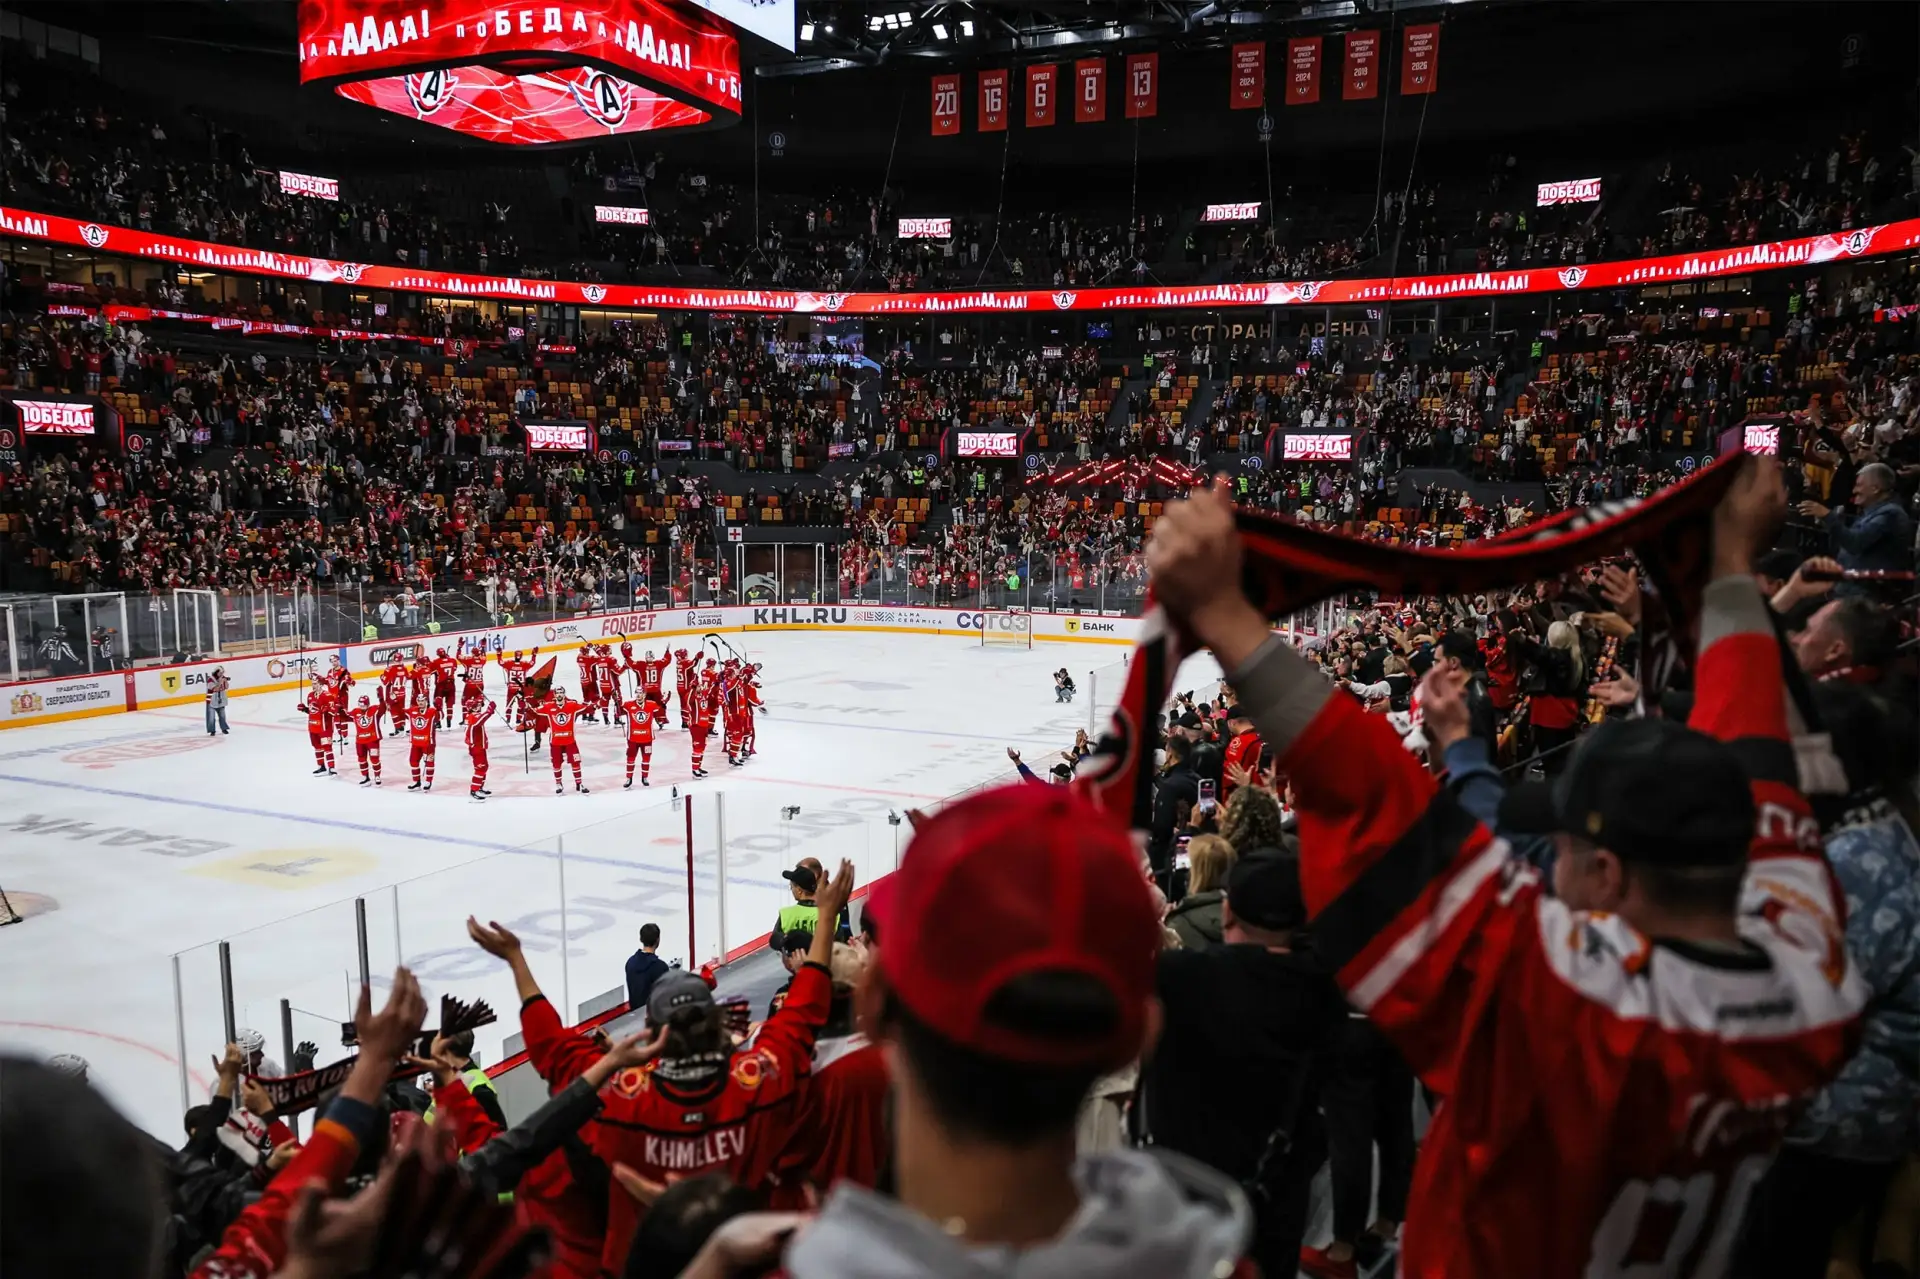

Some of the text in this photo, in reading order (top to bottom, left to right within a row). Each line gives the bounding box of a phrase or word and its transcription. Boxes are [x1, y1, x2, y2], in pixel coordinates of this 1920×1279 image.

[1085, 76, 1097, 101] 8
[1133, 70, 1151, 96] 13
[984, 88, 1002, 113] 16
[1035, 83, 1047, 107] 6
[935, 91, 957, 116] 20
[283, 175, 336, 196] ПОБЕДА!
[1541, 184, 1597, 199] ПОБЕДА!
[597, 209, 646, 223] ПОБЕДА!
[1209, 207, 1258, 219] ПОБЕДА!
[902, 223, 948, 233] ПОБЕДА!
[1300, 321, 1370, 338] АРЕНА
[961, 437, 1014, 450] ПОБЕДА!
[1288, 440, 1347, 453] ПОБЕДА!
[754, 608, 846, 624] KHL.RU
[602, 614, 656, 636] FONBET
[1083, 622, 1114, 632] БАНК
[444, 668, 452, 677] 7
[645, 670, 658, 683] 18
[645, 1126, 745, 1169] KHMELEV
